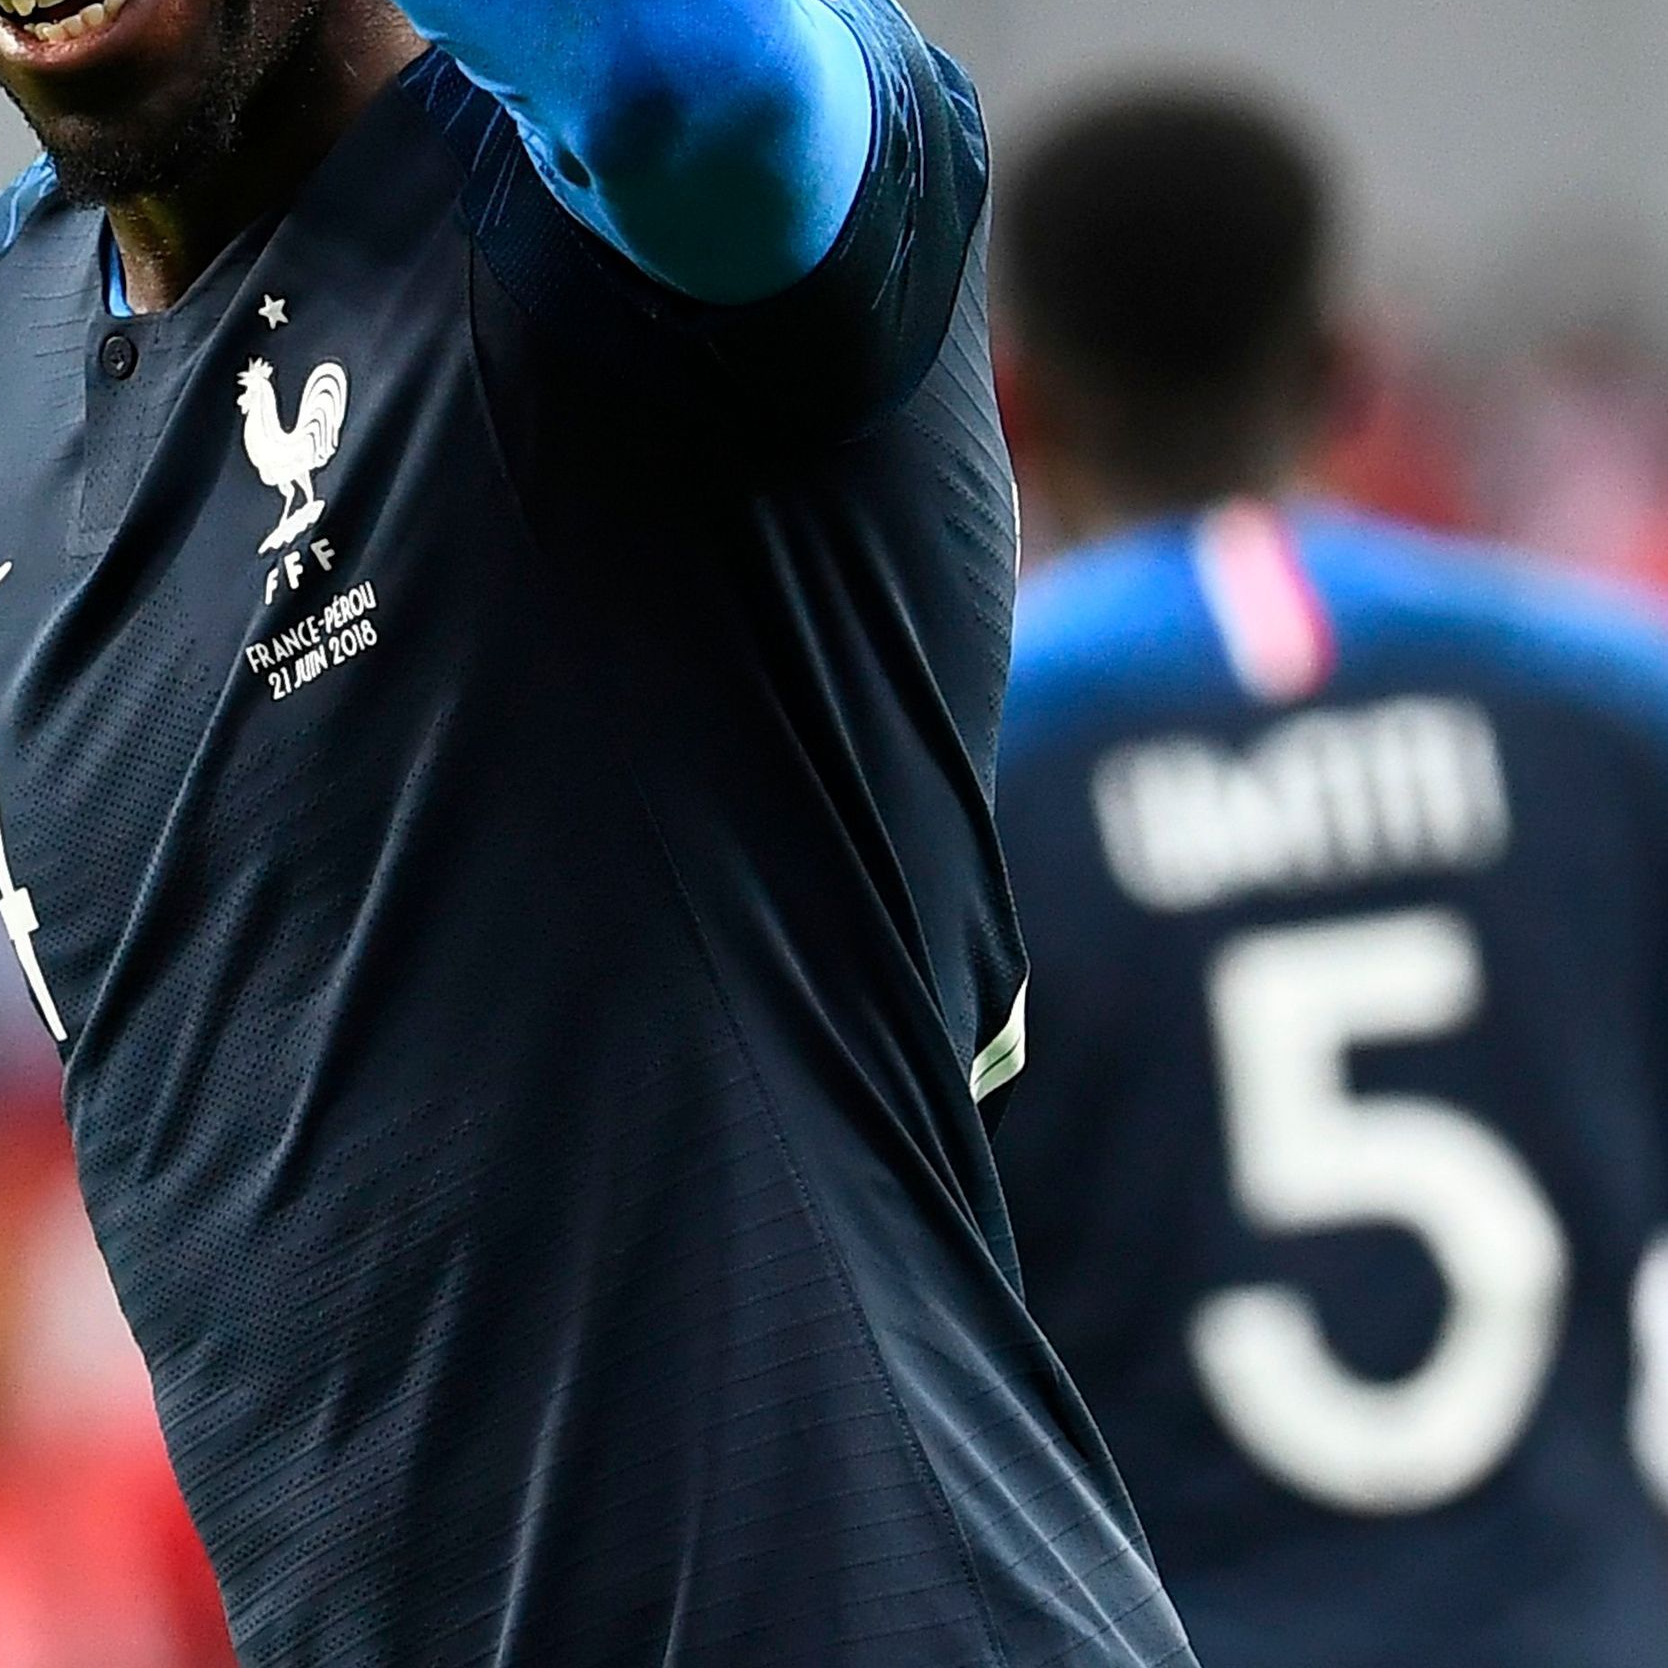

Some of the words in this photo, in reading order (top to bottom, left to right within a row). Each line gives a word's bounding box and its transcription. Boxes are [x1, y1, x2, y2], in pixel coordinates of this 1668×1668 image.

[245, 580, 377, 673] FRANCE-PÉROU
[268, 666, 292, 700] 21
[294, 644, 329, 689] JUIN
[328, 619, 378, 666] 2018
[1188, 907, 1572, 1516] 5
